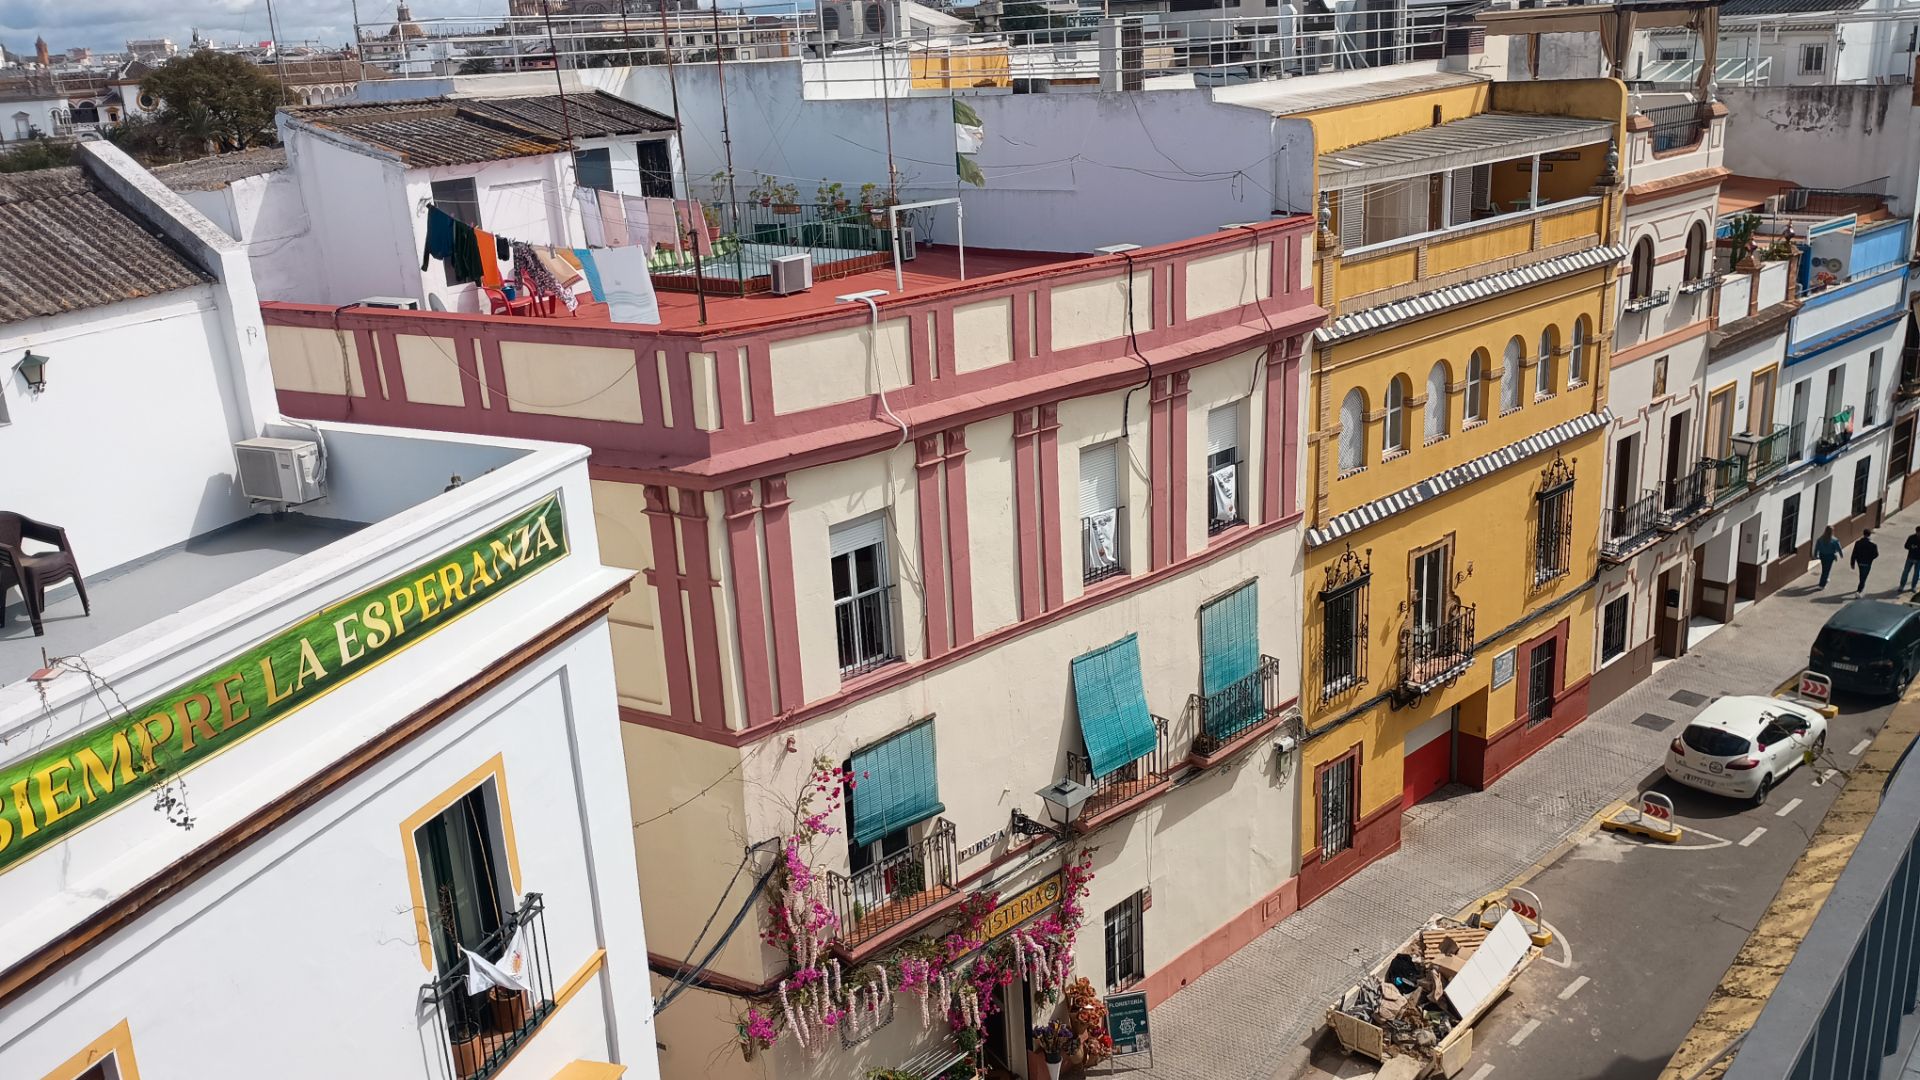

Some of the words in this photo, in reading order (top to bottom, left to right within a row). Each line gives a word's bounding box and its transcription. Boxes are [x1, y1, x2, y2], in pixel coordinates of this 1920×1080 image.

[259, 636, 329, 707] LA
[333, 516, 558, 667] ESPERANZA
[961, 829, 1005, 860] PUREZA
